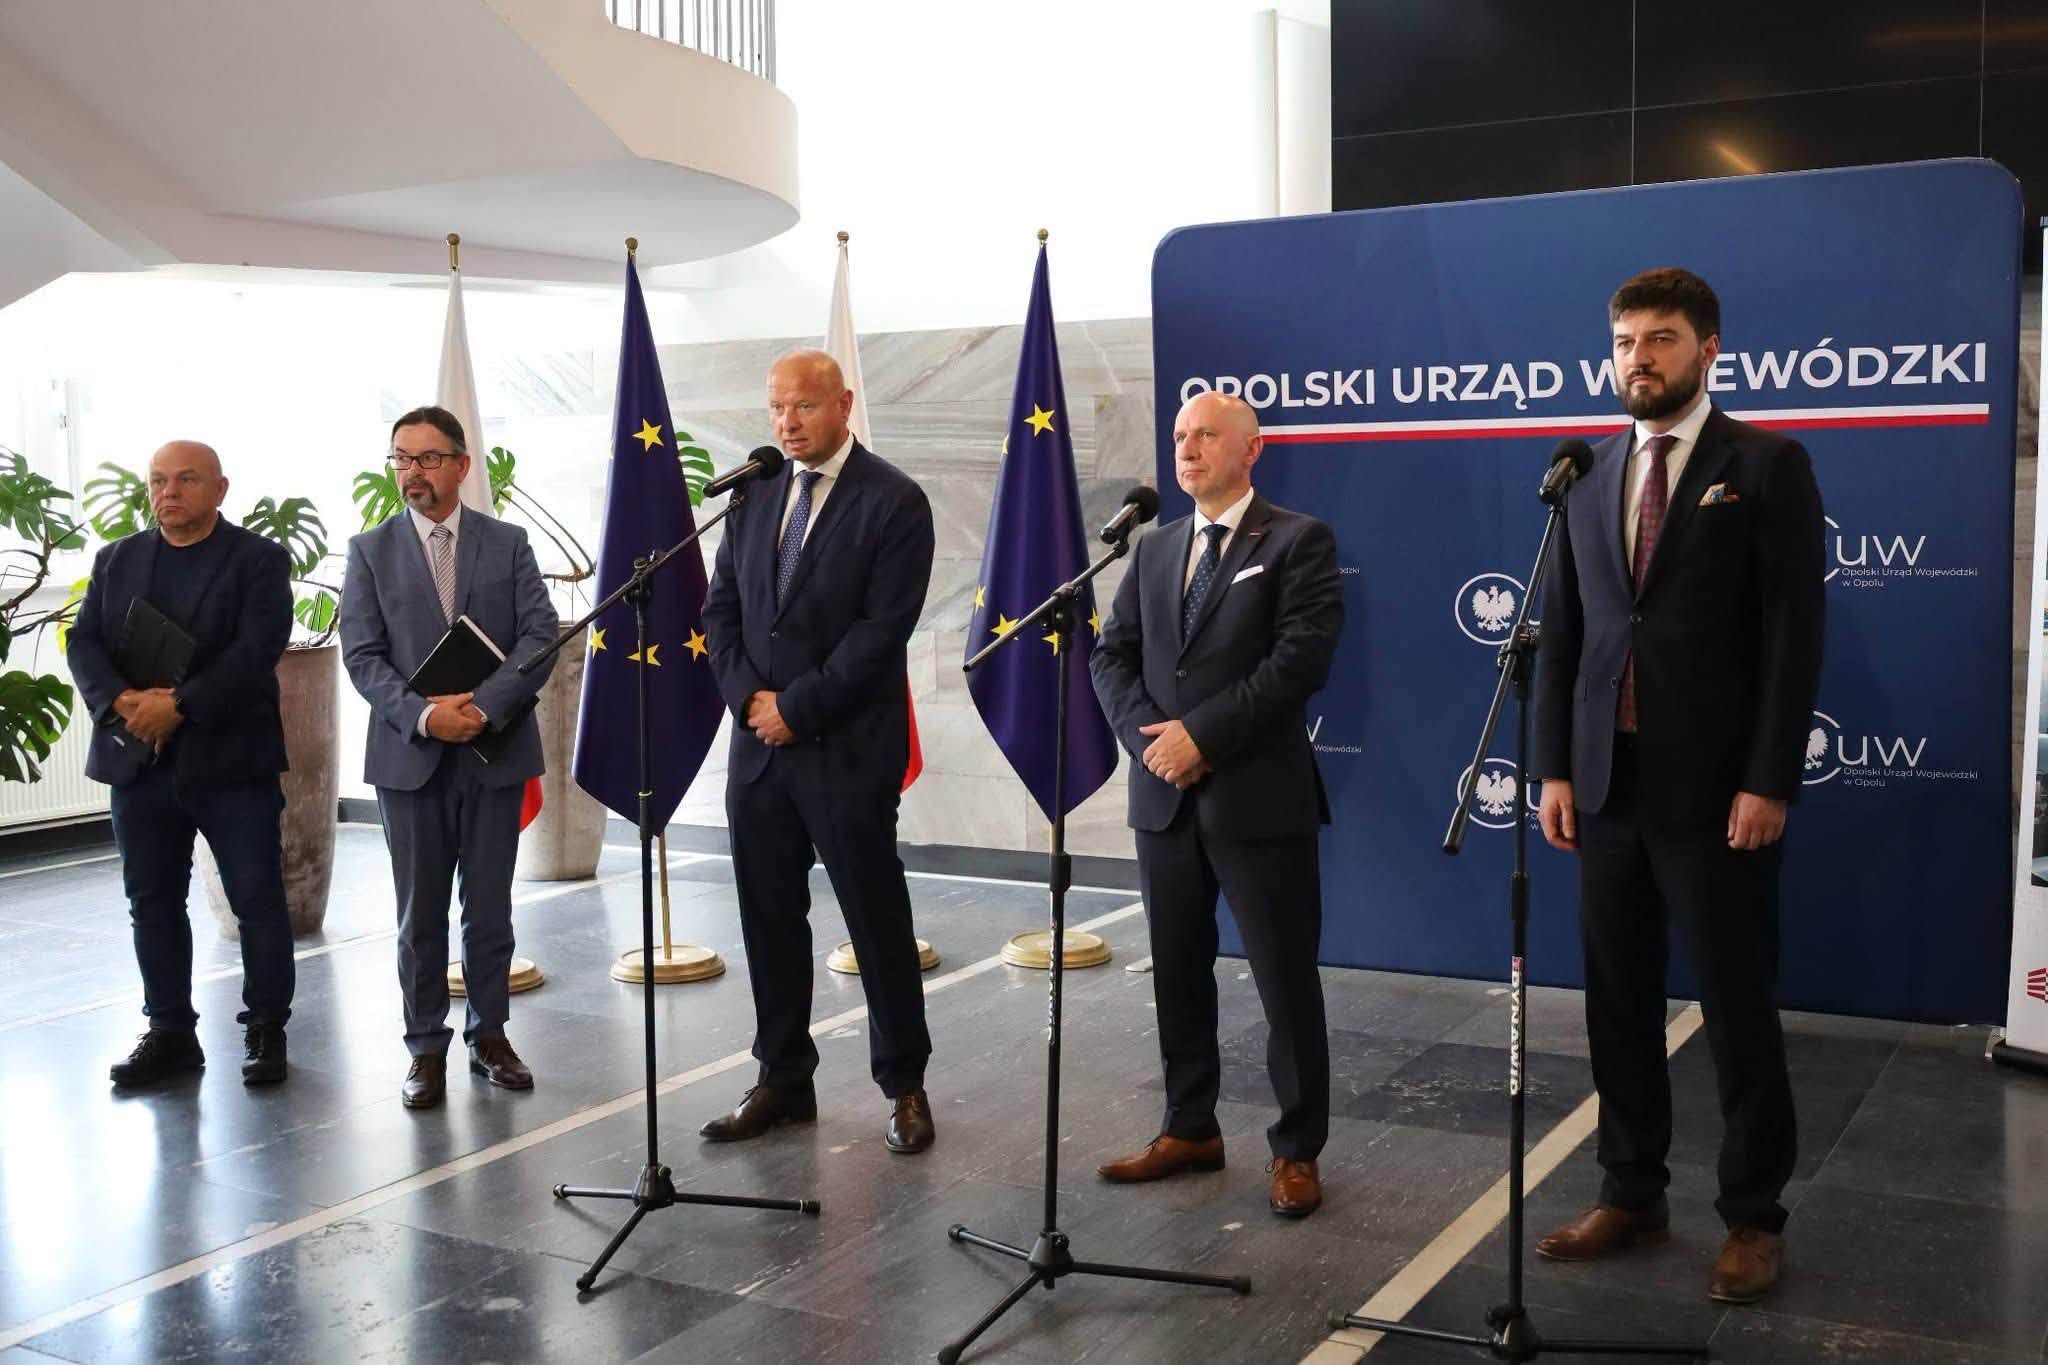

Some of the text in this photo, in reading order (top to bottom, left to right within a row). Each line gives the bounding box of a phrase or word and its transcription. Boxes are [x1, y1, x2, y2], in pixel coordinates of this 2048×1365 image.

[1180, 337, 1988, 411] OPOLSKI URZĄD WEWÓDZKI
[1836, 535, 1927, 566] uw
[1841, 567, 1978, 578] Opolski Urząd Wojewódzki
[1841, 578, 1885, 588] w Opolu
[1837, 735, 1927, 767] uw
[1843, 767, 1979, 780] Opolski Urząd Wojewódzki
[1854, 778, 1886, 788] Opolu
